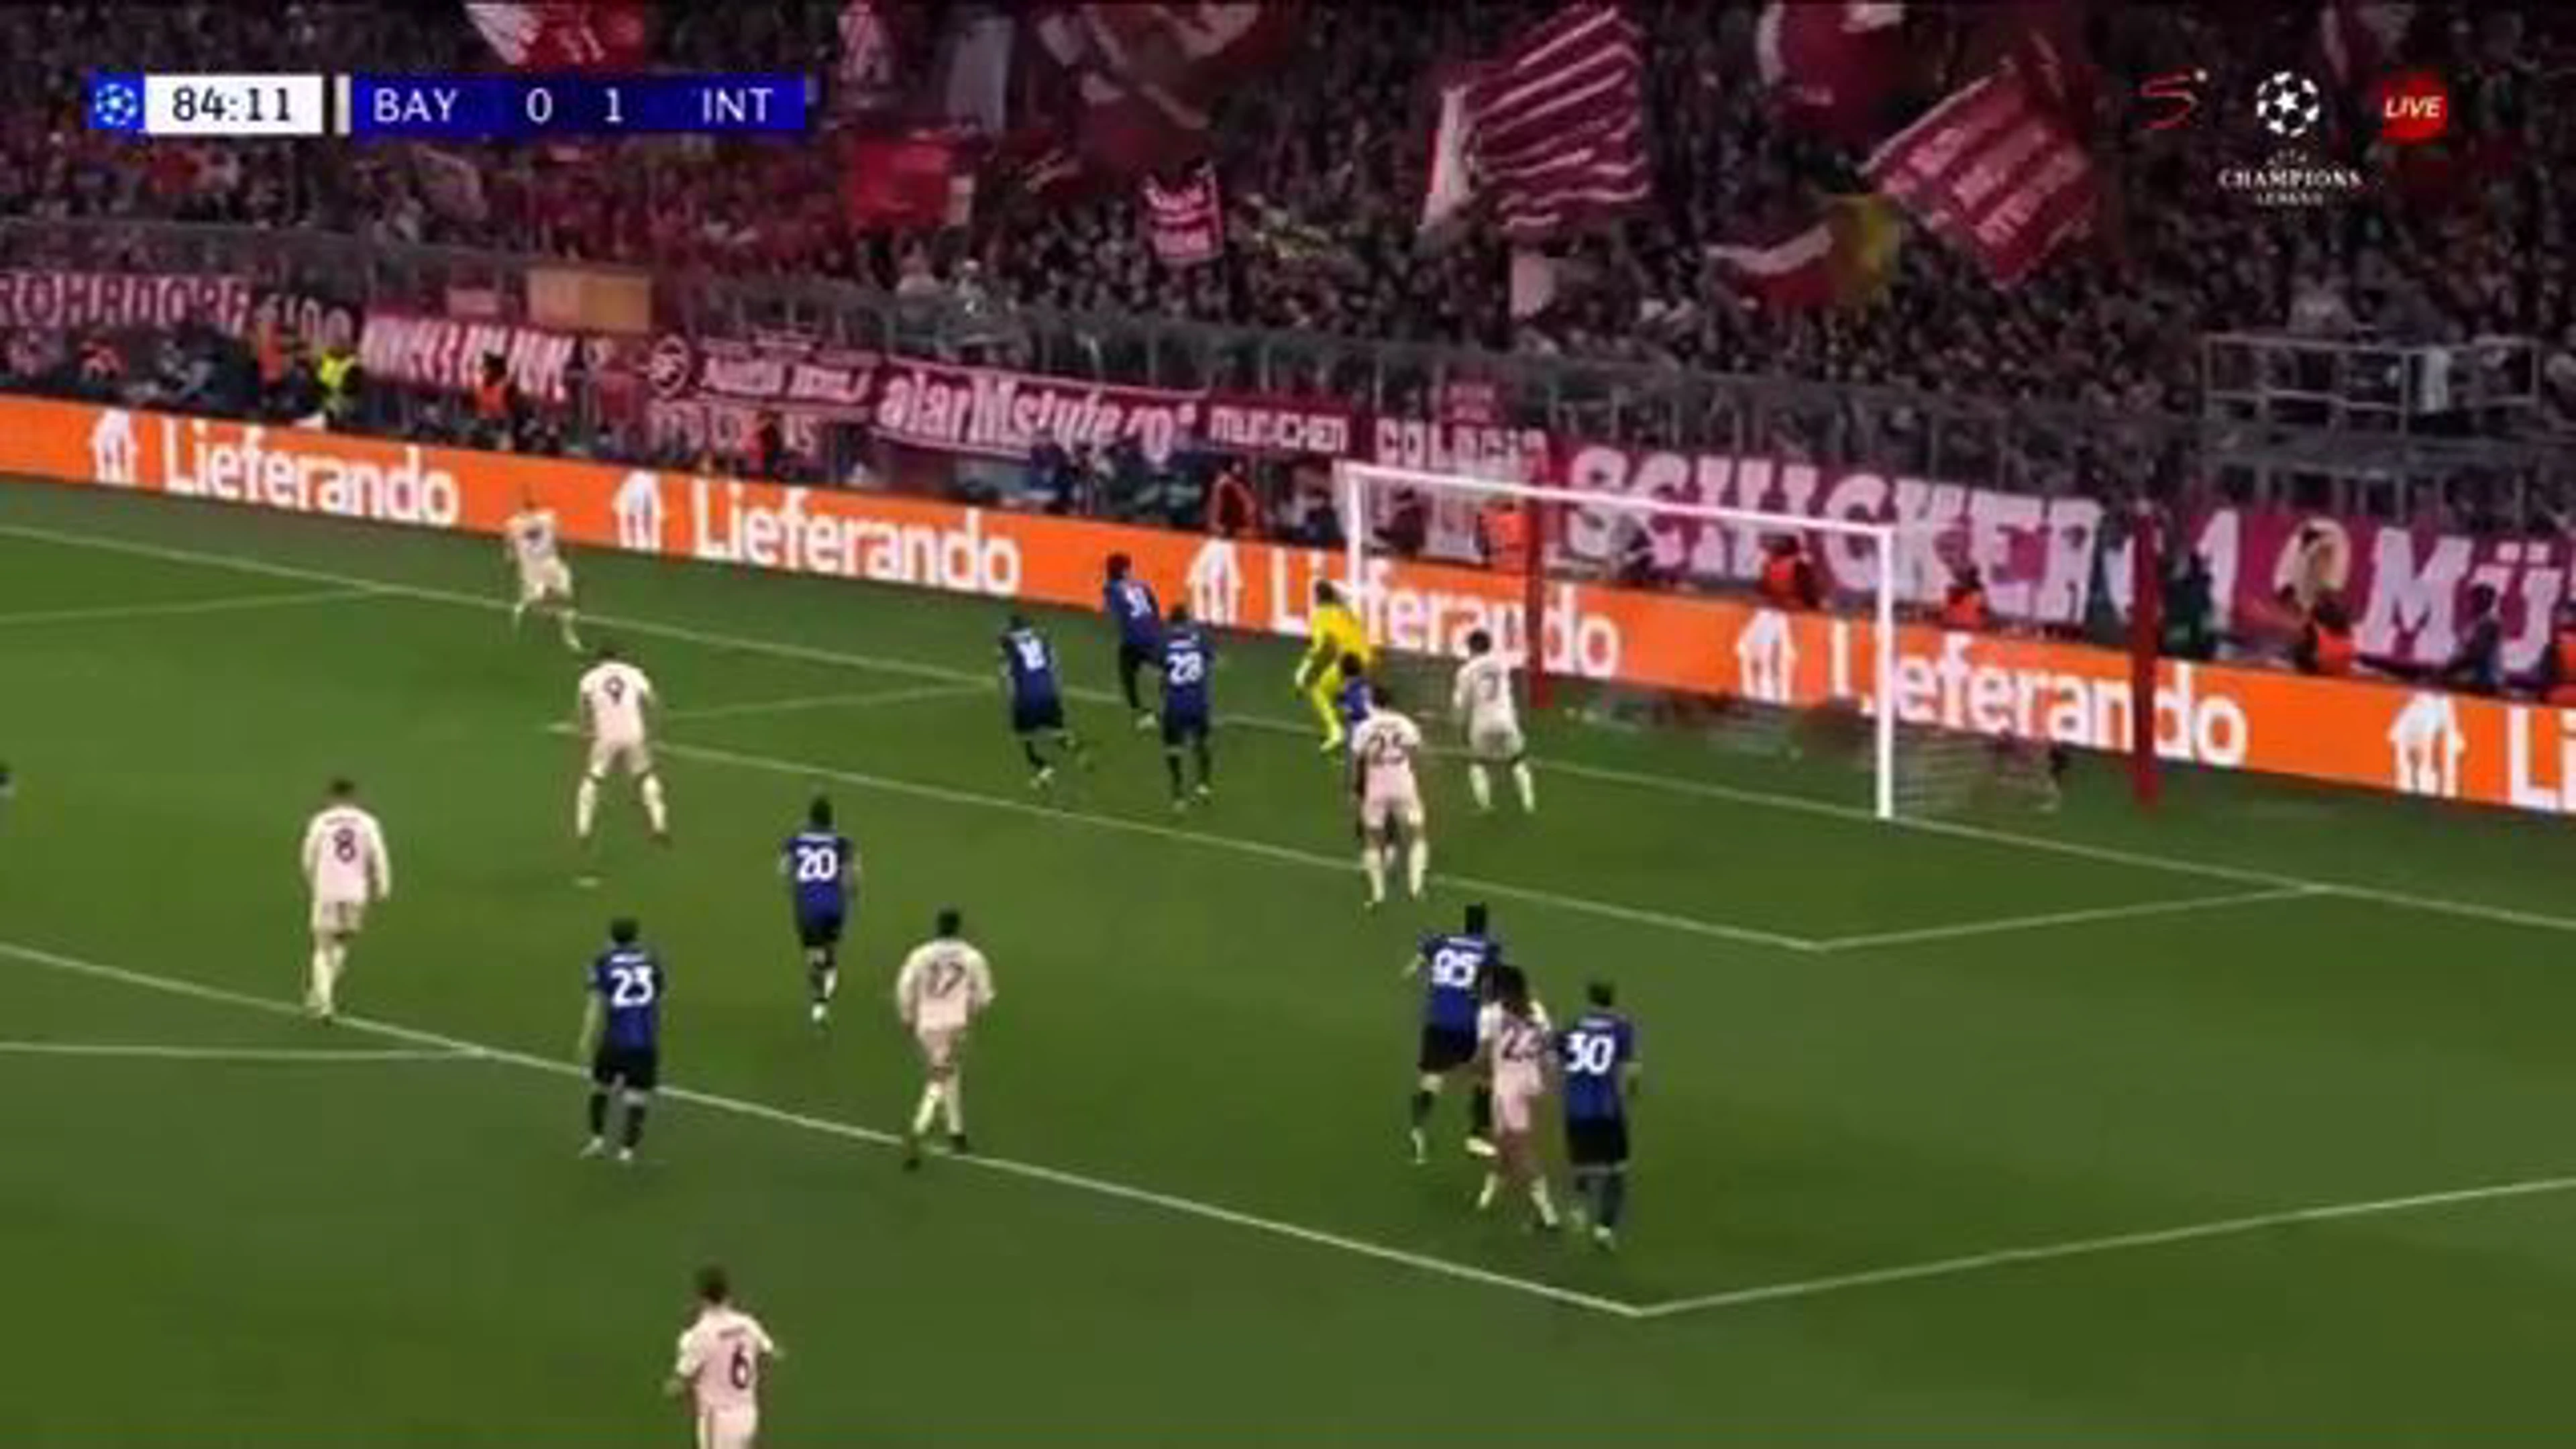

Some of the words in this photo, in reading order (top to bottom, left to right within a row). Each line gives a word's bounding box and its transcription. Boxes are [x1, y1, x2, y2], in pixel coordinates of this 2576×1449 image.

[162, 416, 460, 525] Lieferando
[691, 475, 1022, 596] Lieferando
[1271, 545, 1620, 679] Lferando
[2352, 527, 2576, 672] MÜ
[602, 674, 625, 706] 9
[1166, 651, 1205, 686] 28
[1831, 616, 2247, 768] Leferando
[333, 826, 356, 863] 8
[796, 847, 839, 882] 20
[611, 965, 653, 1008] 23
[1432, 949, 1483, 988] 95
[1564, 1031, 1614, 1075] 30
[731, 1342, 749, 1390] 6
